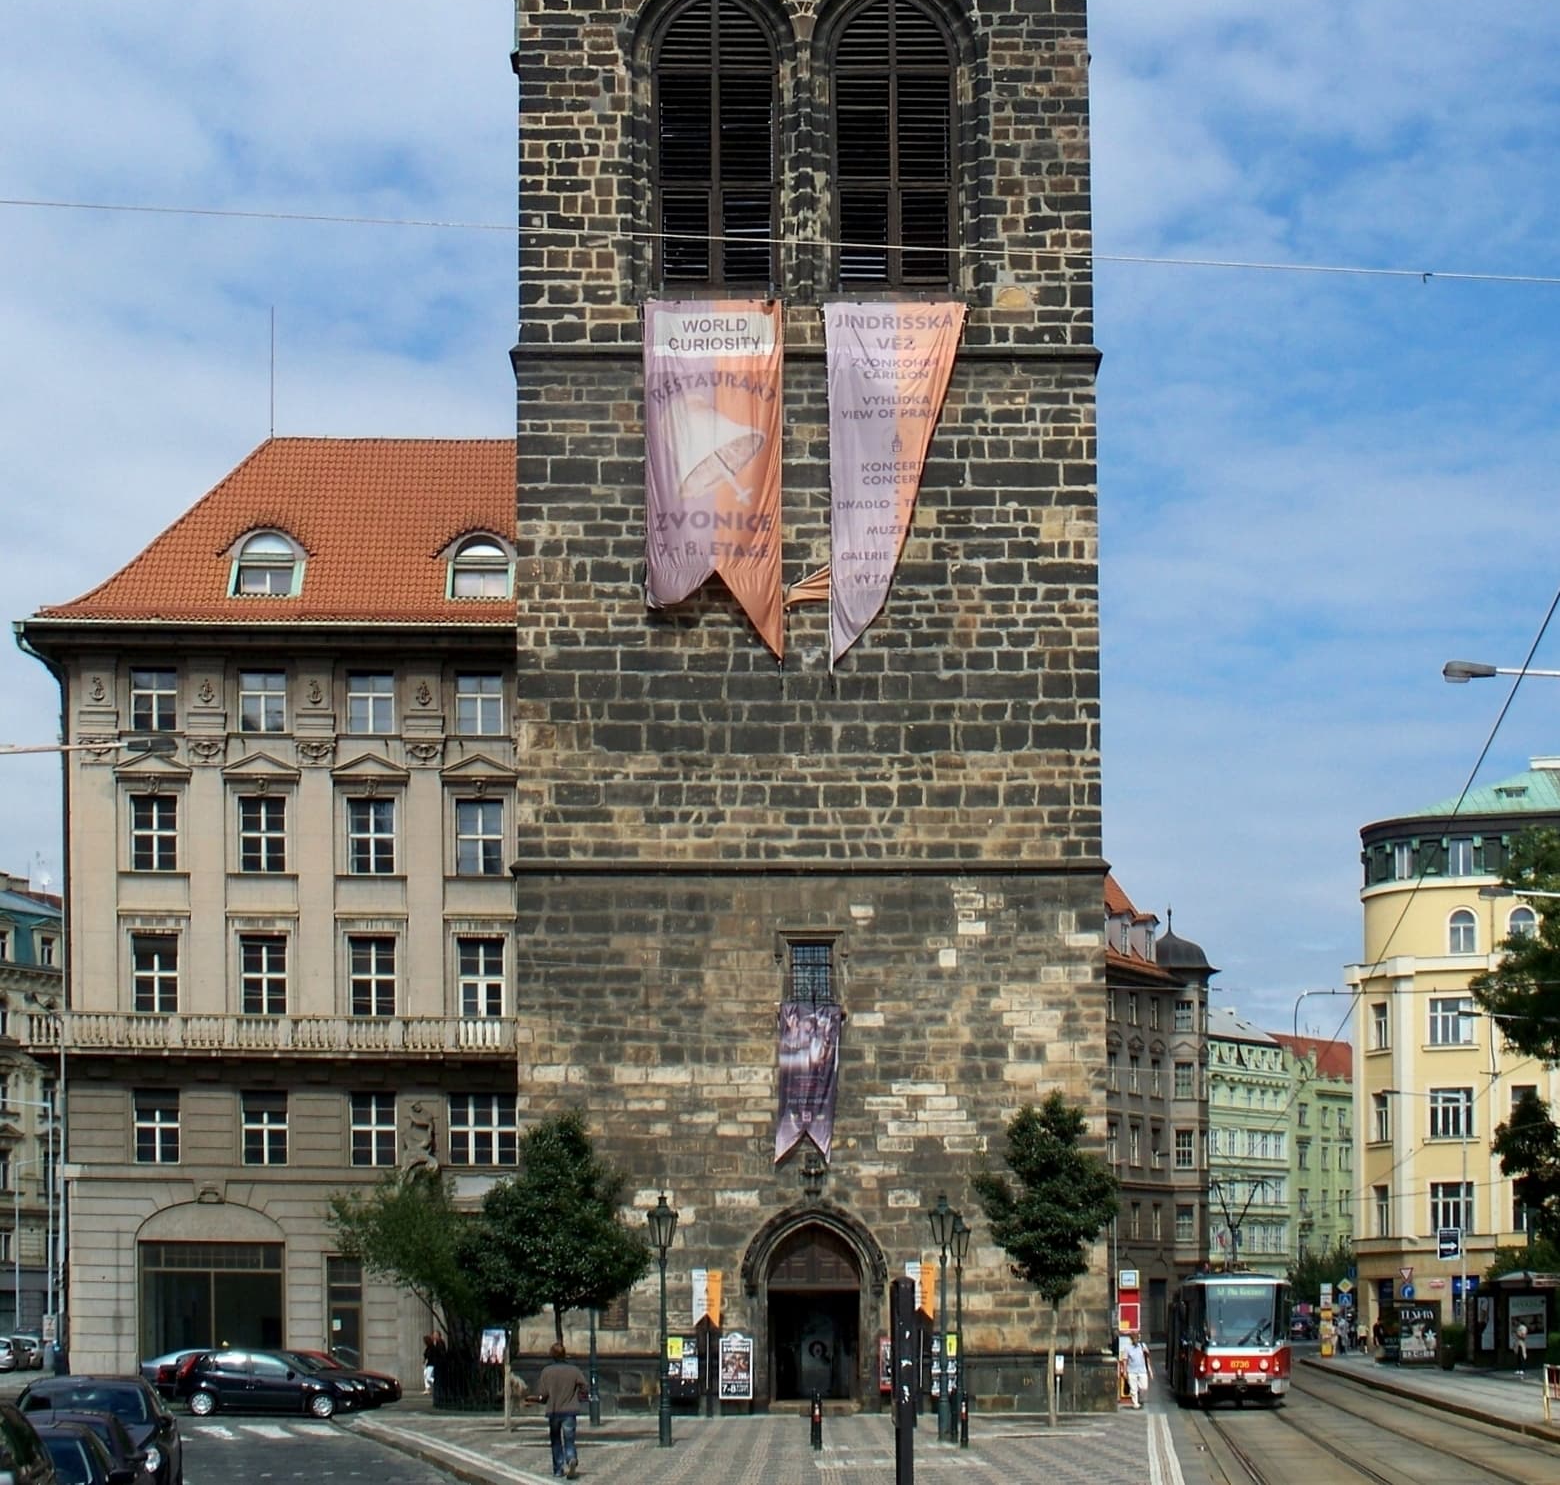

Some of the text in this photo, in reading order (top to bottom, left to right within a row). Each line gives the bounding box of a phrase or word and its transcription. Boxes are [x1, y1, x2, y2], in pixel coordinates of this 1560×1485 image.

[682, 318, 748, 333] WORLD
[668, 335, 761, 352] CURIOSITY
[863, 370, 929, 380] CARILLON
[841, 409, 873, 420] VIEW
[878, 409, 896, 419] OF
[656, 510, 771, 532] ZVONICE
[840, 551, 889, 561] GALERIE
